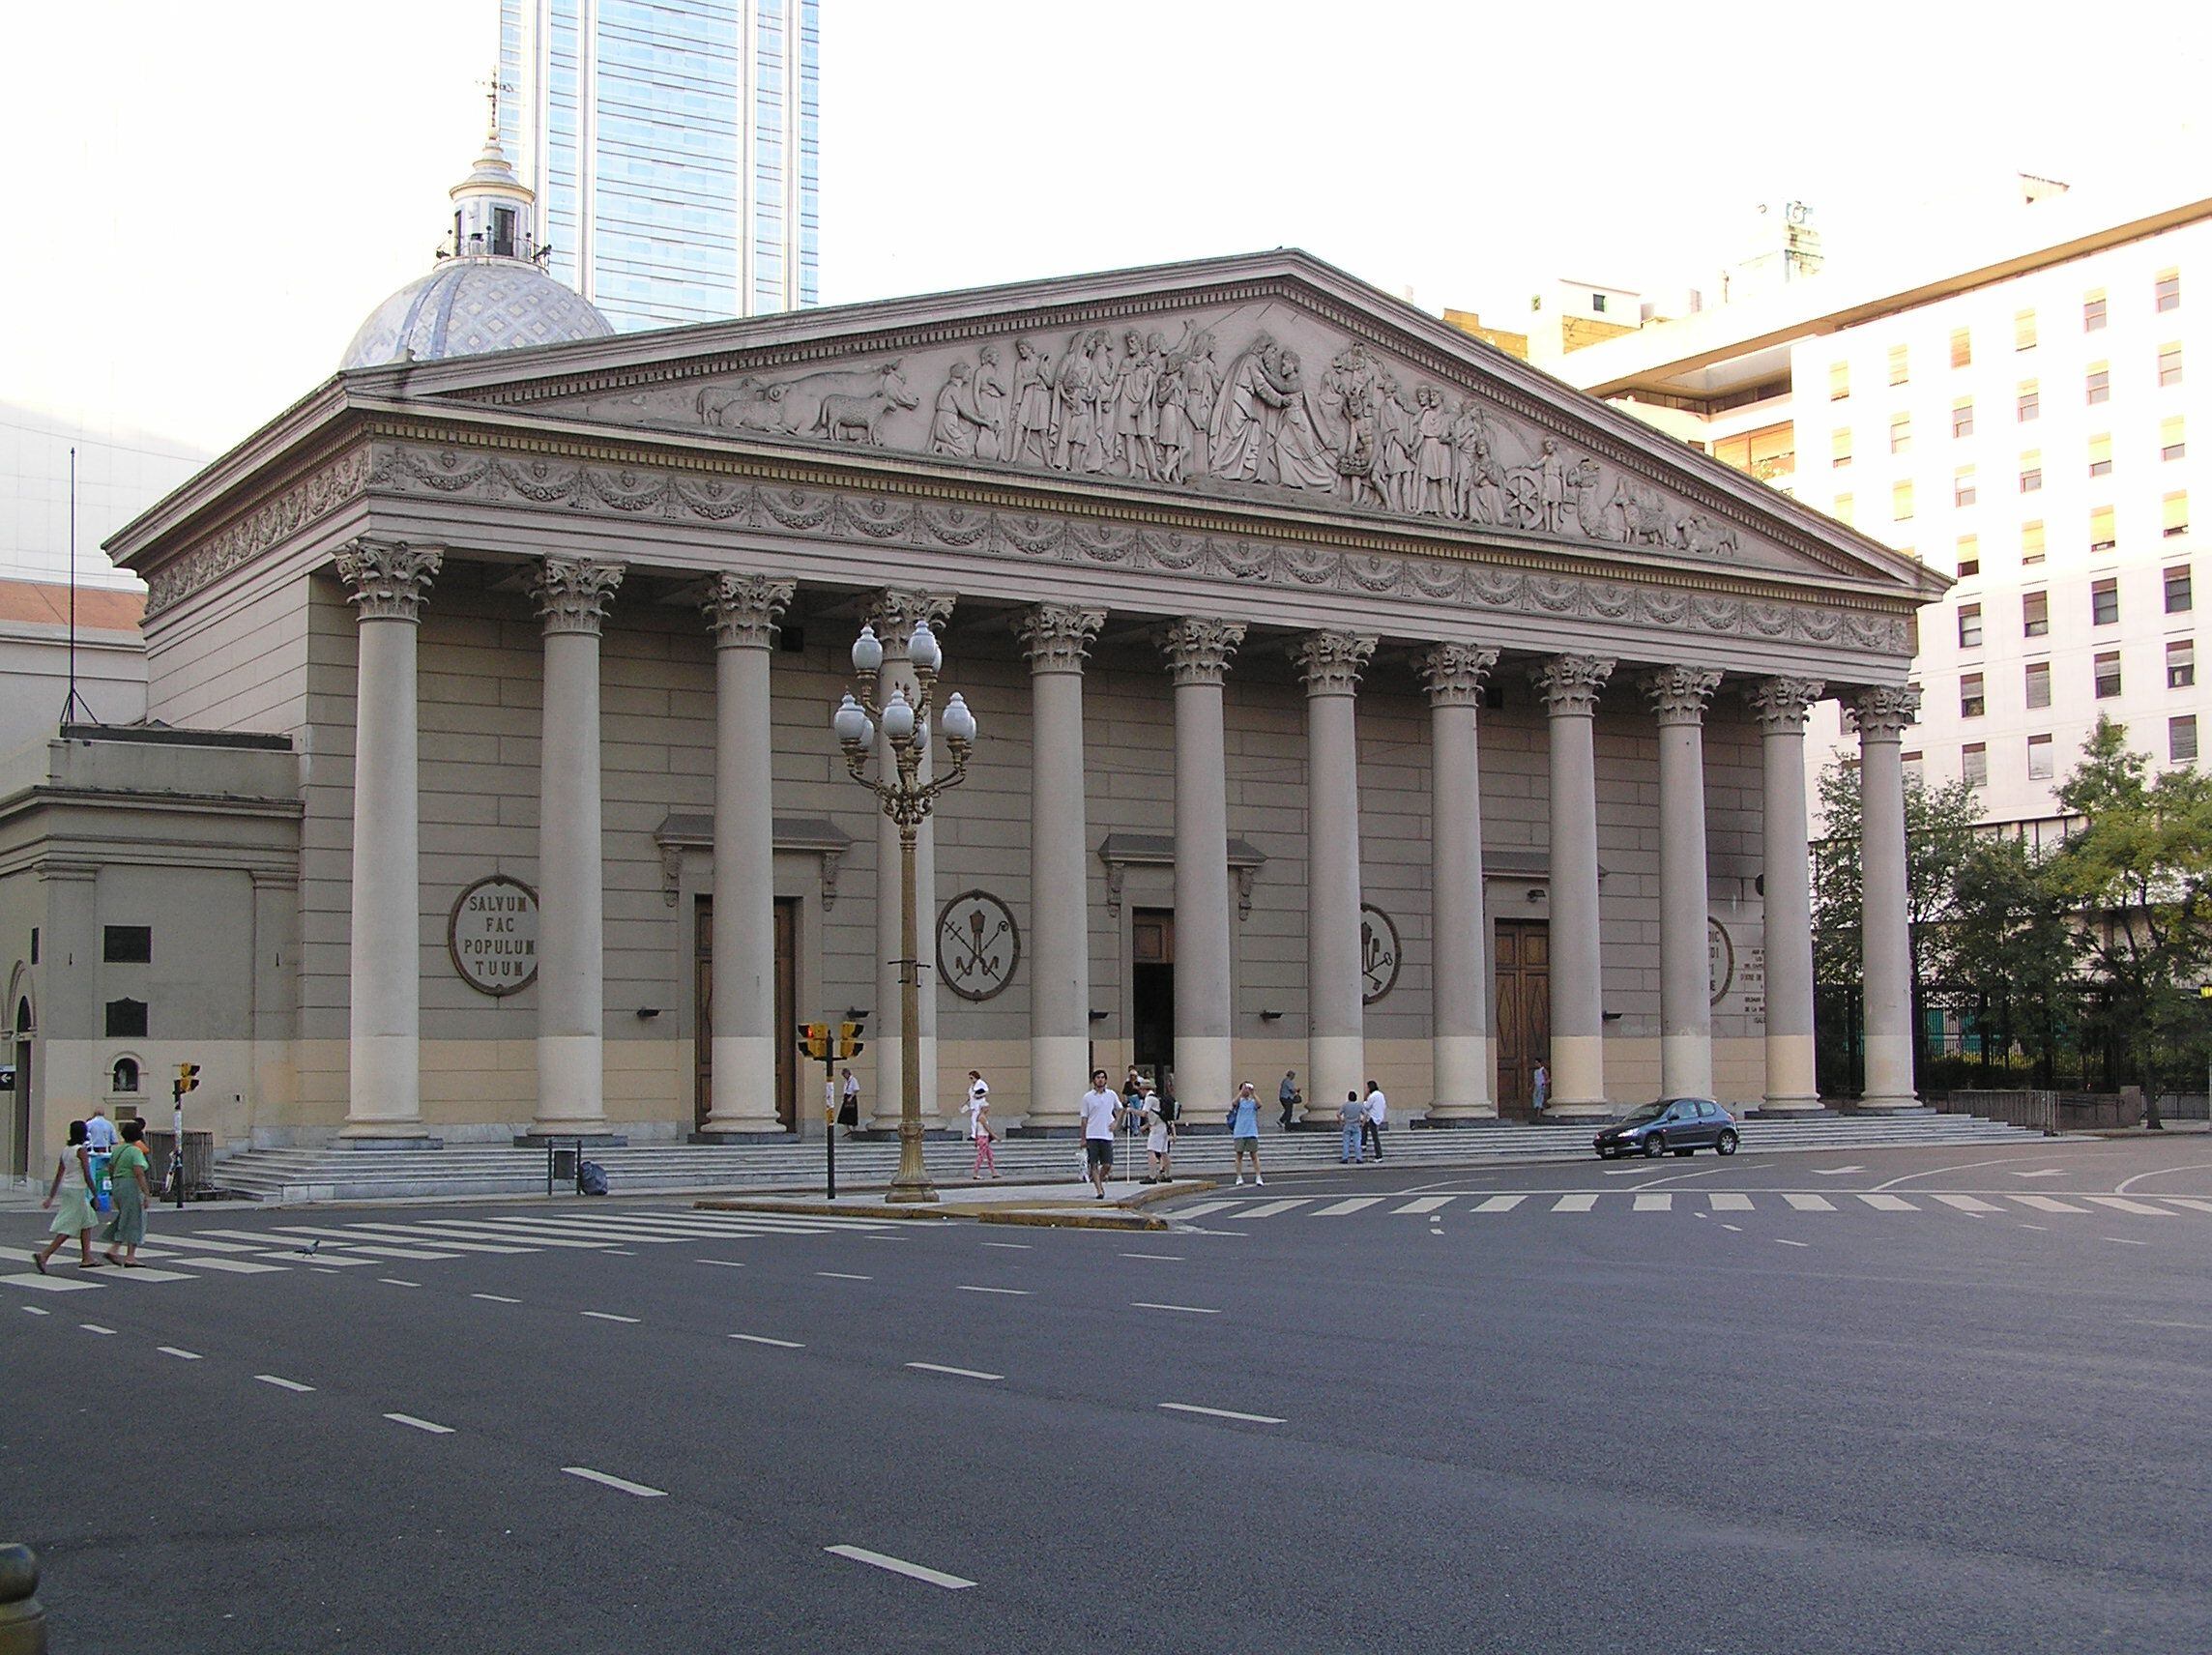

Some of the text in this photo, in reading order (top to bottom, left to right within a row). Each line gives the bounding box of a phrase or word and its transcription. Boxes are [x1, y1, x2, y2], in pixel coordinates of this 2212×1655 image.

[486, 917, 514, 933] FAC
[464, 939, 535, 955] POPULUM
[476, 961, 523, 976] TUUM
